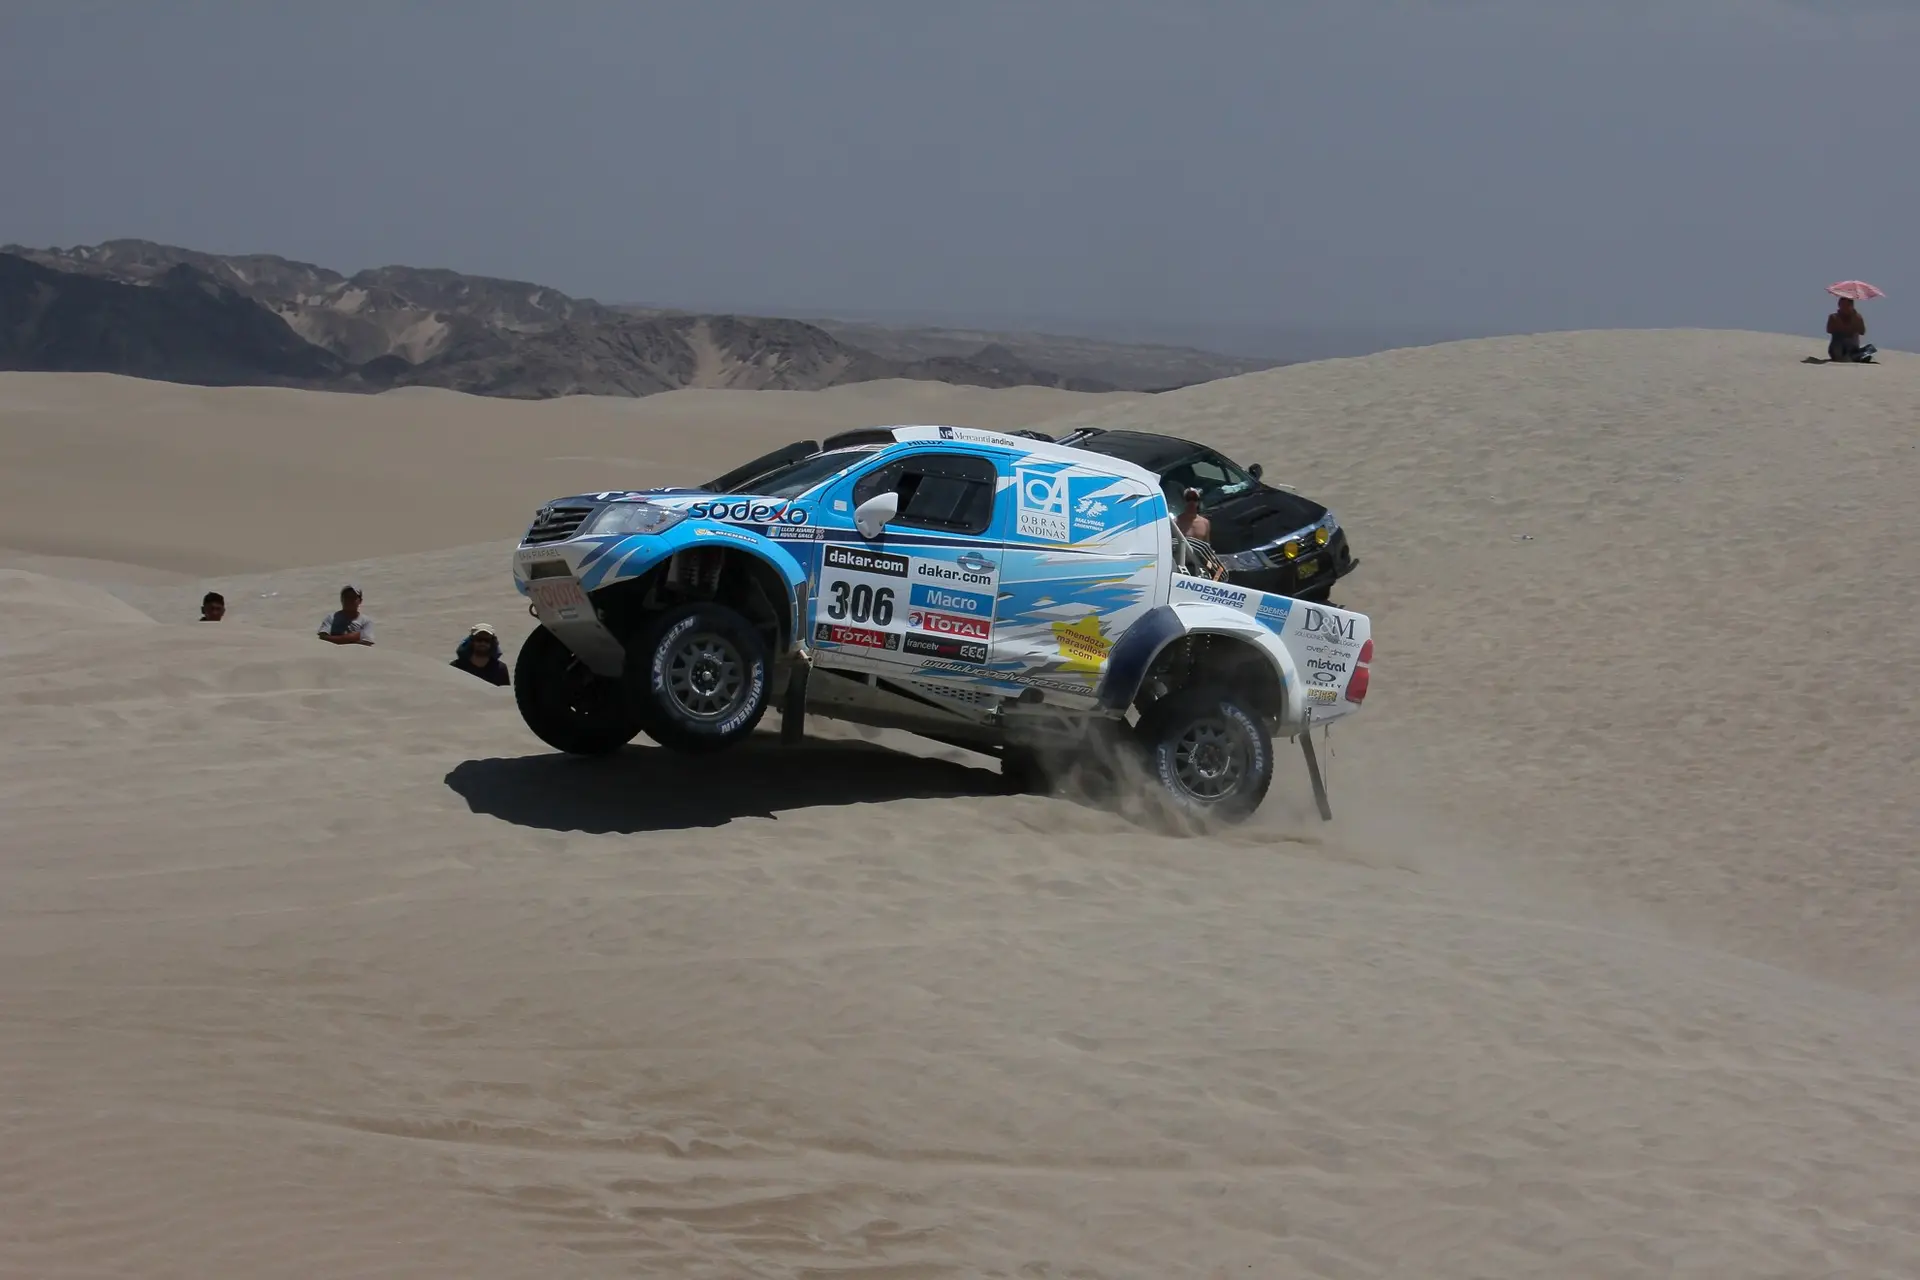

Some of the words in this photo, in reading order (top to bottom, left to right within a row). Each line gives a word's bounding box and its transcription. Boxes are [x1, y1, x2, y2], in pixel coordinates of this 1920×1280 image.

[691, 500, 808, 526] sodexo
[1021, 515, 1066, 530] OBRAS
[715, 530, 757, 543] MICHELIN
[1021, 525, 1066, 540] ANDINAS
[829, 550, 904, 572] dakar.com
[918, 564, 991, 585] dakar.com
[926, 590, 978, 611] Macro
[1176, 581, 1247, 602] ANDESMAR
[1200, 594, 1244, 609] CARGAS
[827, 580, 895, 626] 306
[1259, 605, 1288, 617] EDEMSA
[927, 614, 987, 637] TOTAL
[1302, 607, 1356, 641] D&M
[653, 616, 695, 674] MICHELIN
[834, 627, 882, 646] TOTAL
[906, 637, 939, 652] francetv
[1056, 635, 1107, 659] maravillosa
[1065, 628, 1105, 649] mendoza
[1306, 659, 1347, 673] mistral
[1306, 679, 1342, 689] OAKLEY
[720, 679, 763, 734] MICHELIN
